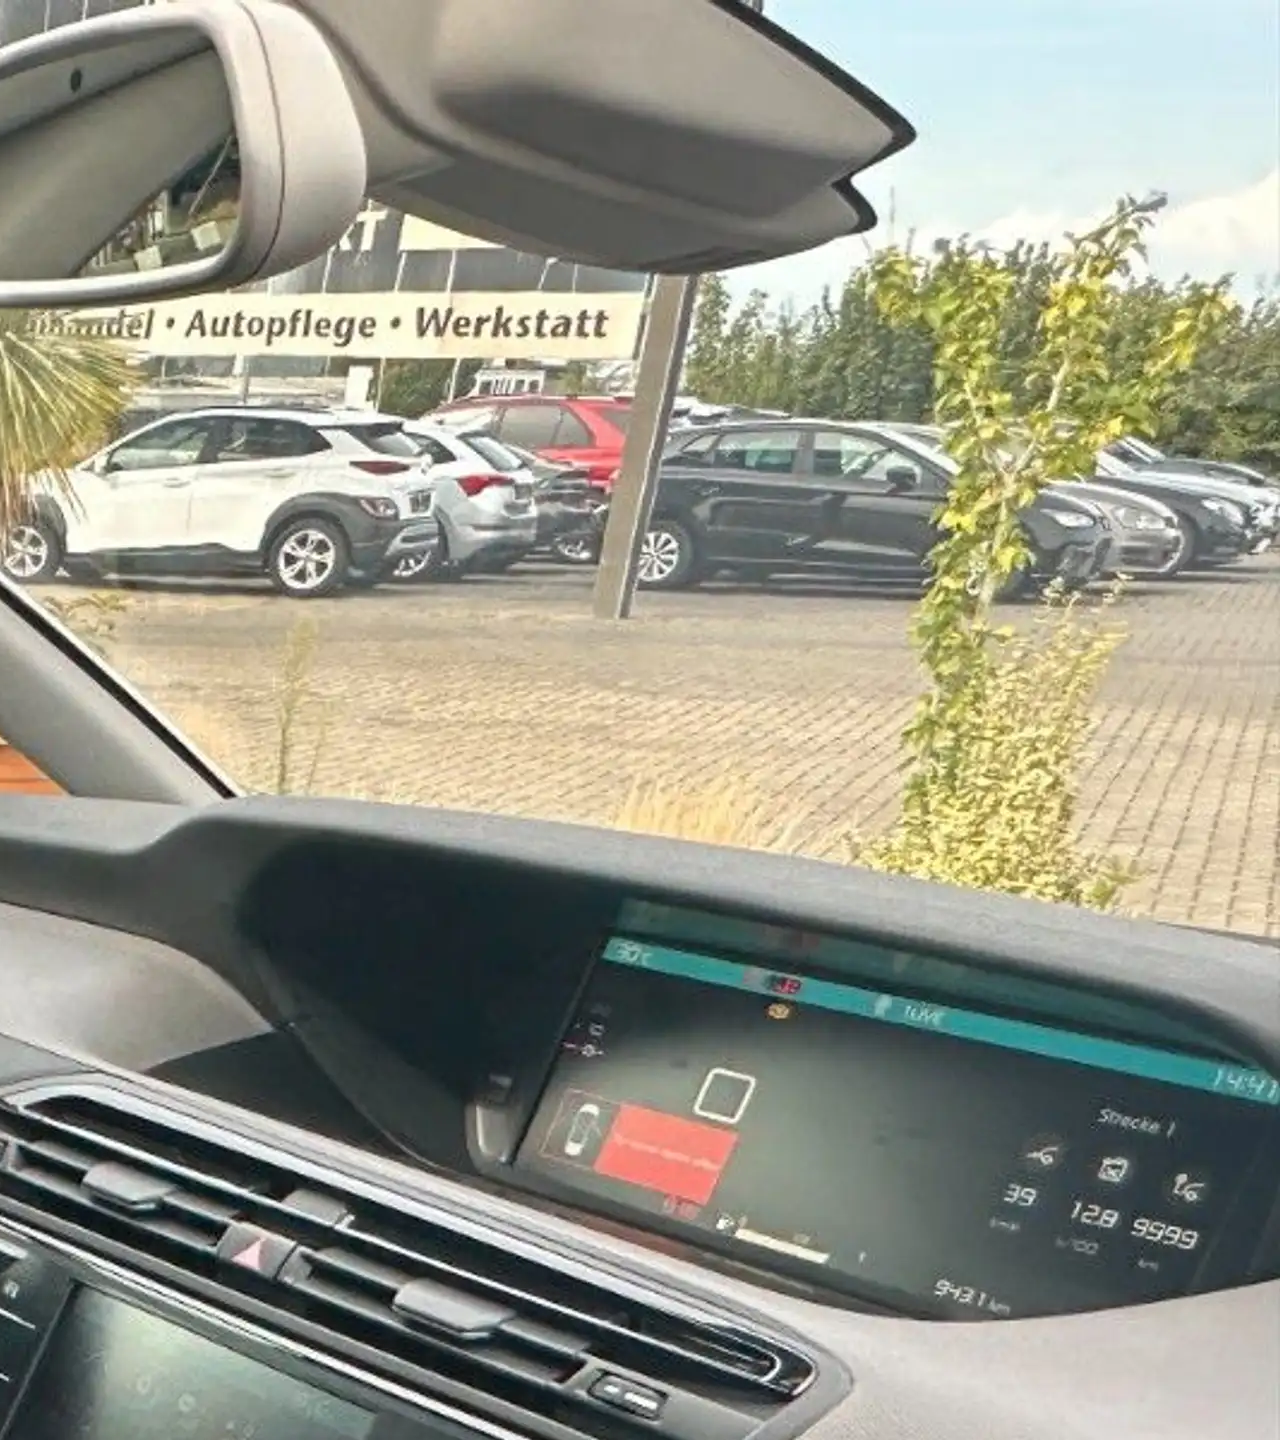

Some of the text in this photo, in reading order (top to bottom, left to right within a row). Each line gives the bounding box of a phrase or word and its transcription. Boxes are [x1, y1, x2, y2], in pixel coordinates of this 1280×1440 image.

[184, 309, 377, 347] Autopflege
[415, 305, 610, 339] Werkstatt
[1003, 1183, 1037, 1207] 39
[1130, 1217, 1200, 1250] 9999
